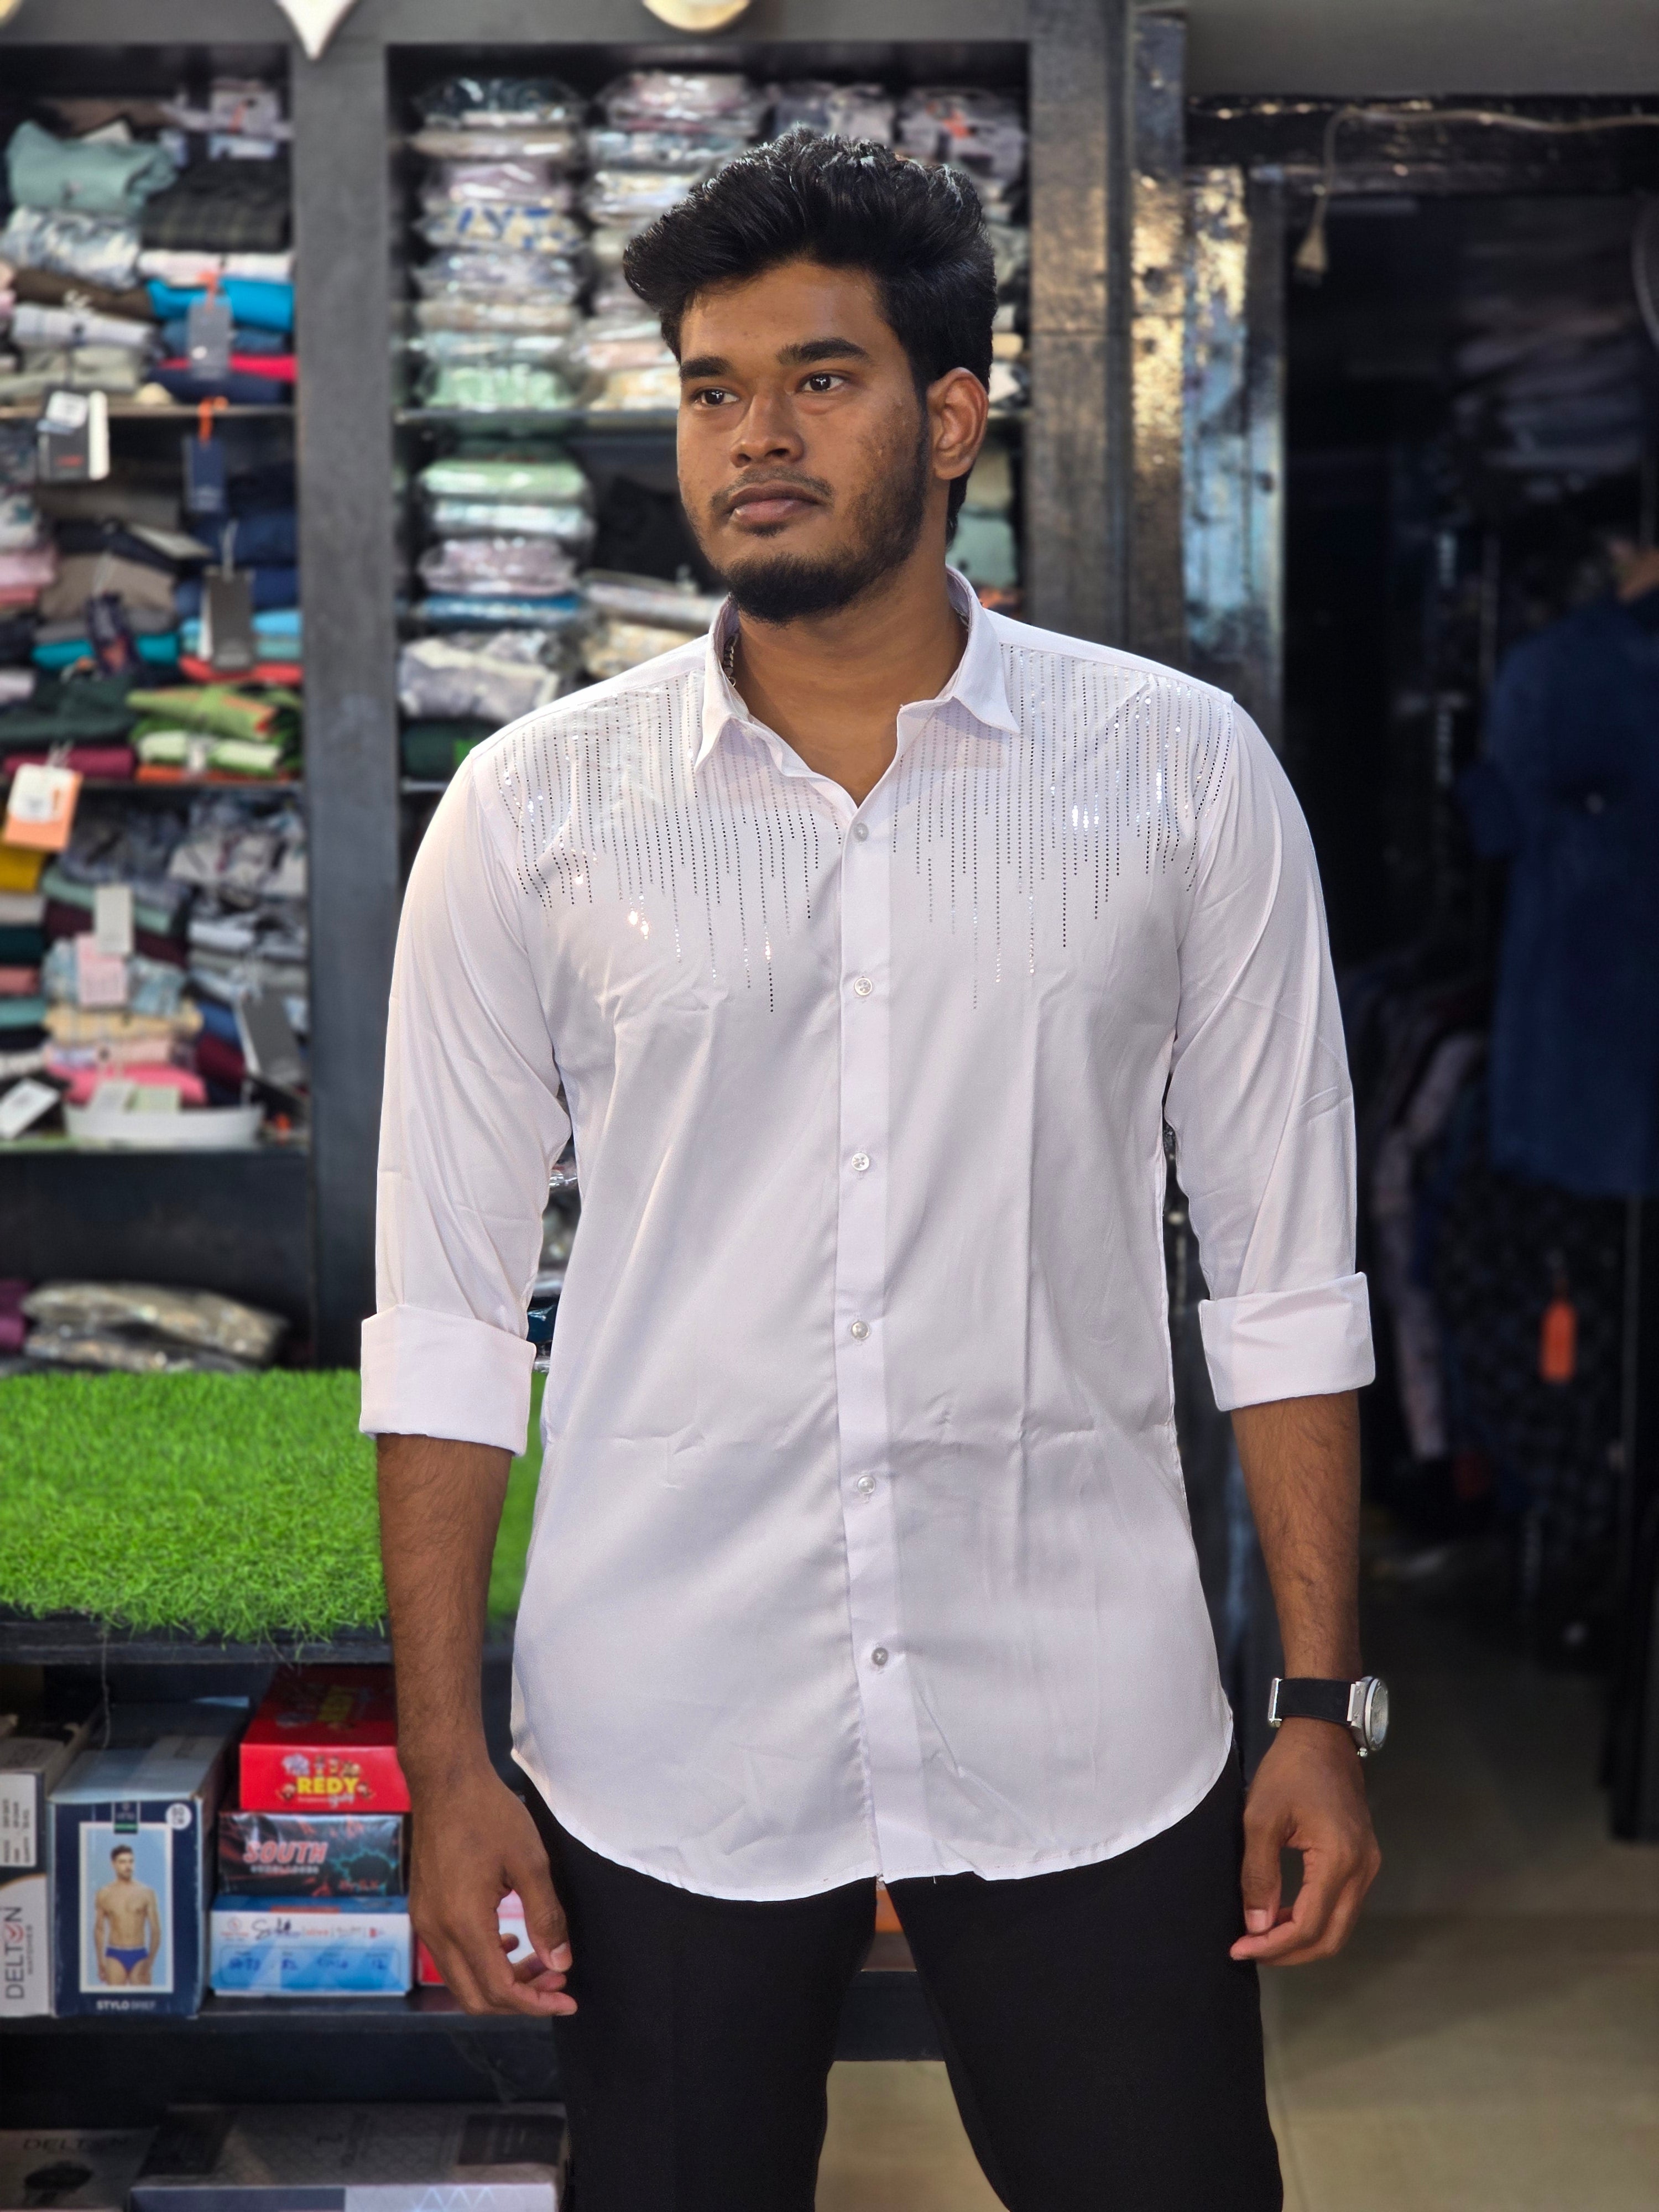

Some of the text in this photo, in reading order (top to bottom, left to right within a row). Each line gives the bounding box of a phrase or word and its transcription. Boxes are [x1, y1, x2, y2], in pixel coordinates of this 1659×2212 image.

[297, 1777, 358, 1794] REDY
[243, 1840, 328, 1864] SOUTH
[96, 1999, 130, 2011] STYLO
